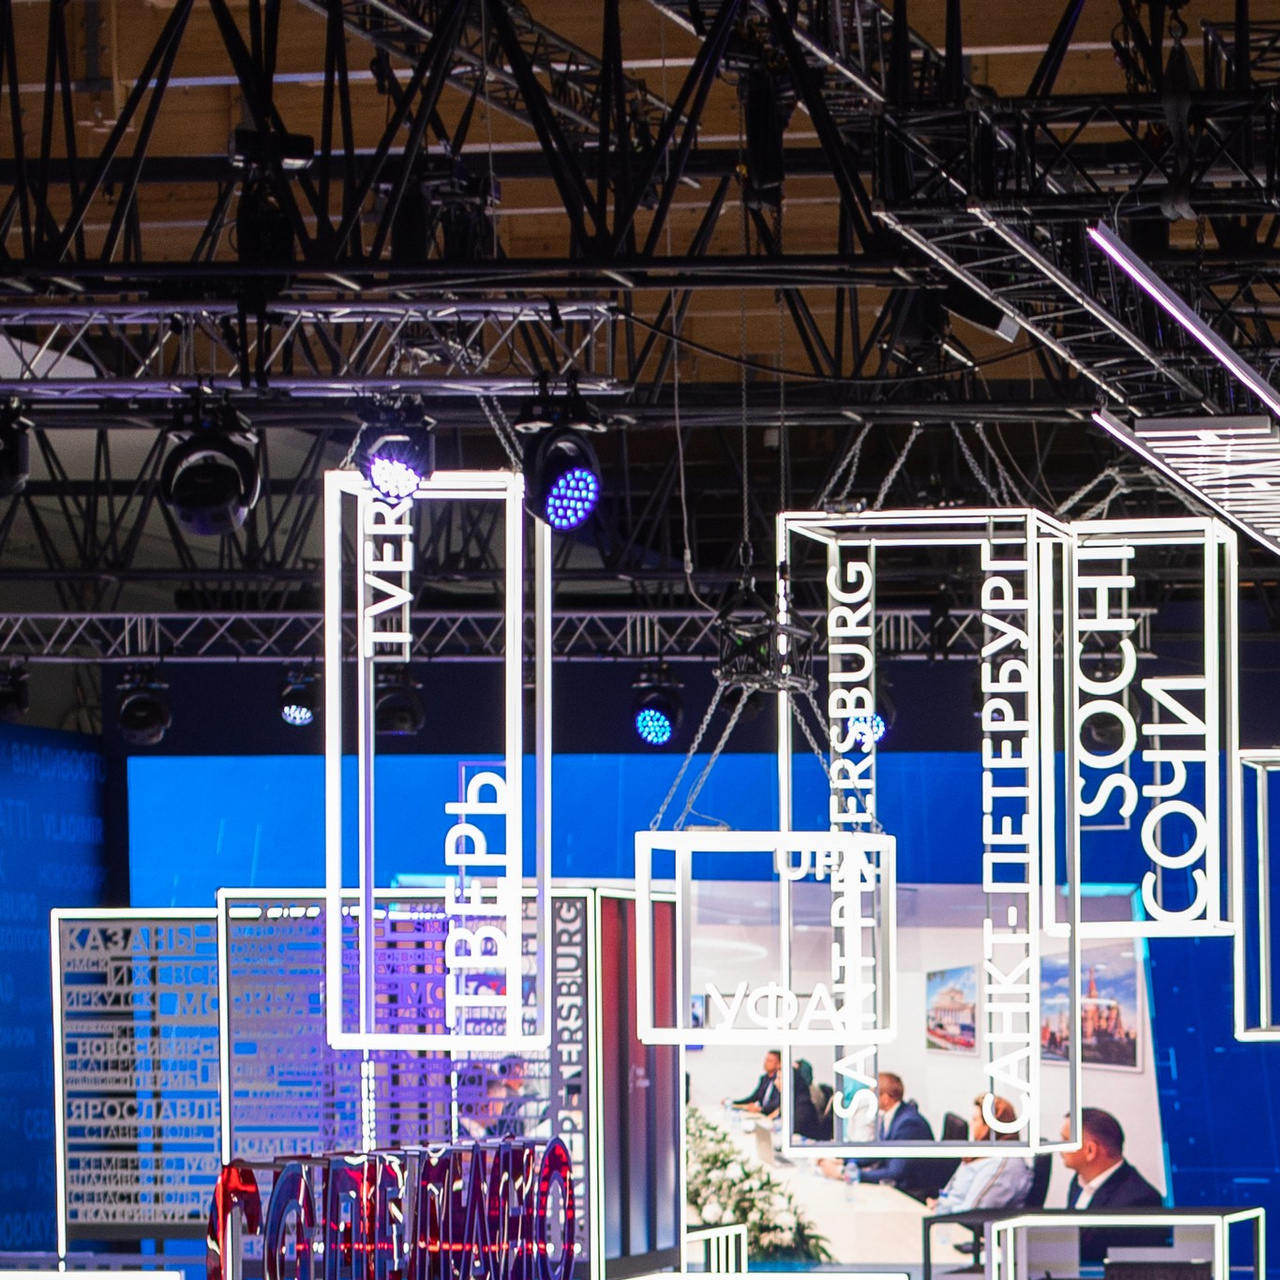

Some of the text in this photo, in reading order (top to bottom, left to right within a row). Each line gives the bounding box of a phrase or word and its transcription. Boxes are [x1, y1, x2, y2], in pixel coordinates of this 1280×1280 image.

[364, 497, 414, 657] TVER
[1079, 547, 1137, 819] SOCHI
[1141, 675, 1206, 924] СОЧИ
[68, 926, 193, 951] КАЗАНЬ
[444, 770, 508, 1029] ТВЕРЬ
[66, 991, 156, 1007] ИРКУТСК
[704, 980, 847, 1031] УФА
